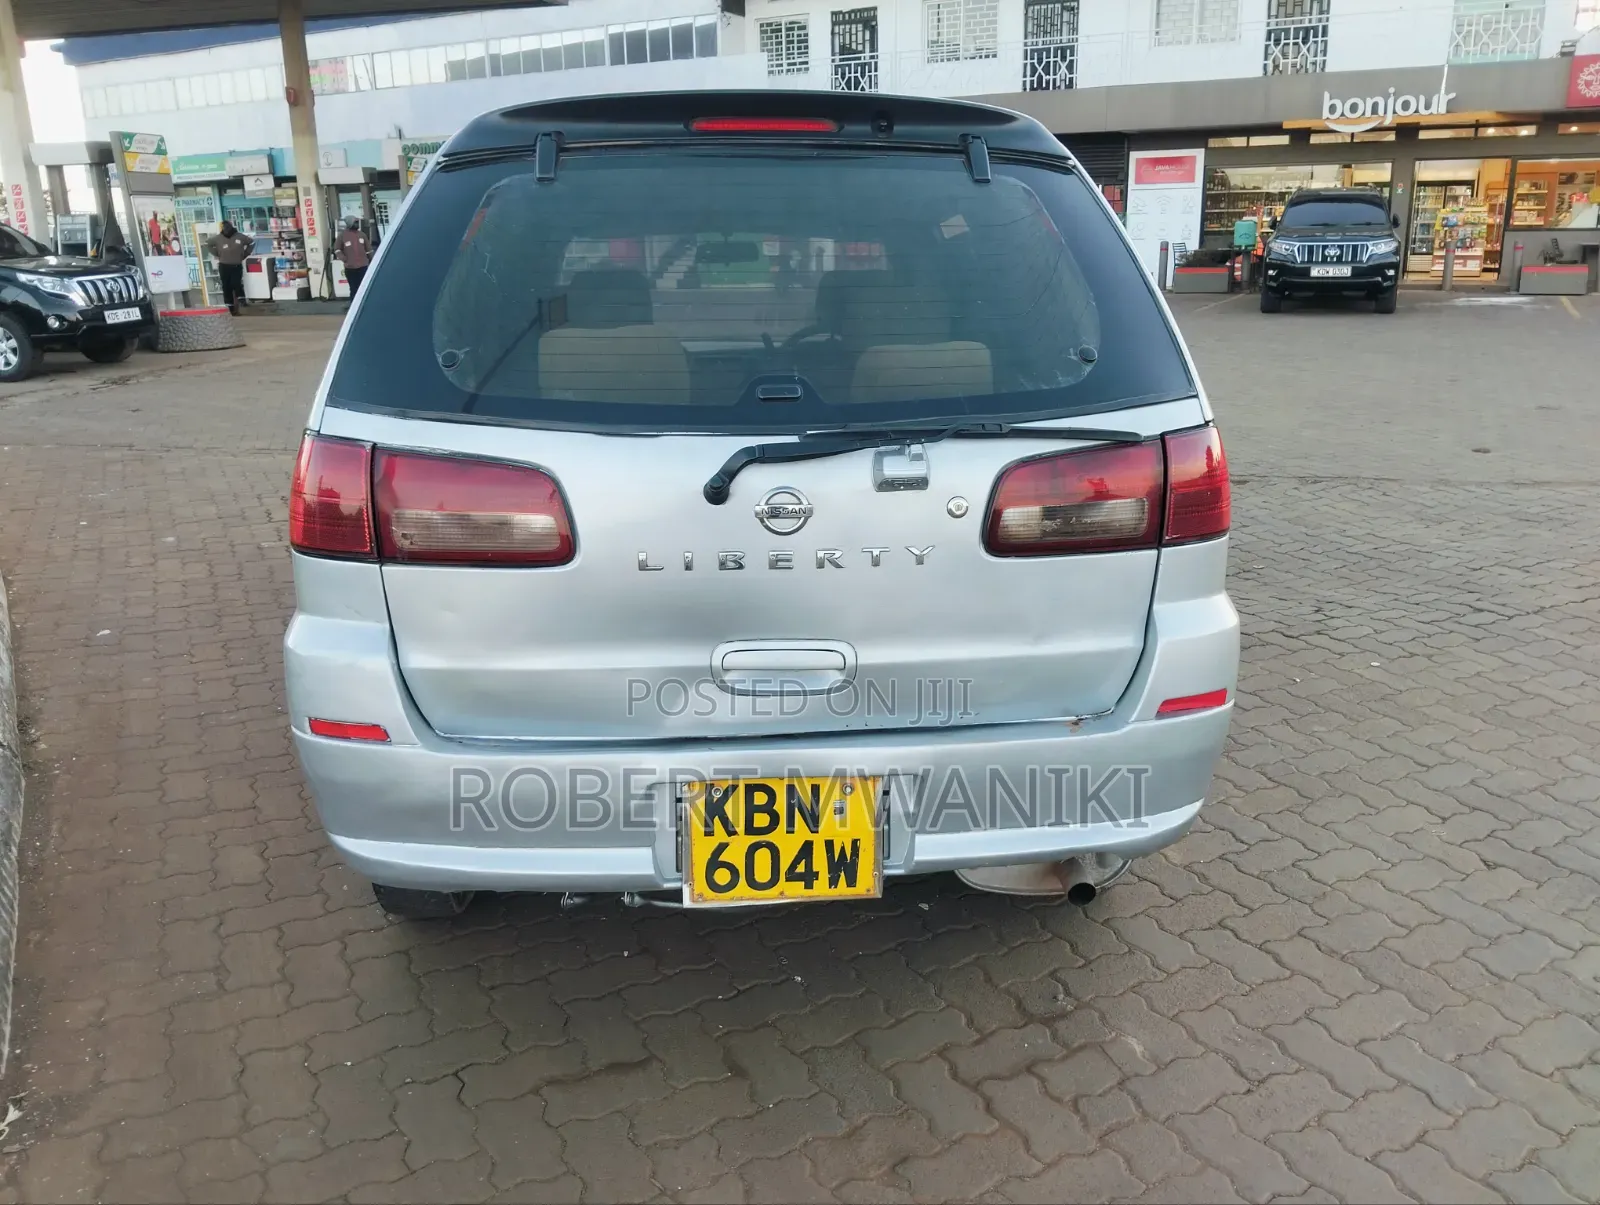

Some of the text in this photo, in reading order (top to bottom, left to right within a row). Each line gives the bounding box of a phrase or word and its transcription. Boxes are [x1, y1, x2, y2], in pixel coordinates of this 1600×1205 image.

[1322, 87, 1457, 126] bonjour
[761, 507, 807, 517] NISSAN
[637, 545, 936, 572] LIBERTY
[703, 783, 821, 838] KBN
[704, 838, 861, 894] 604W
